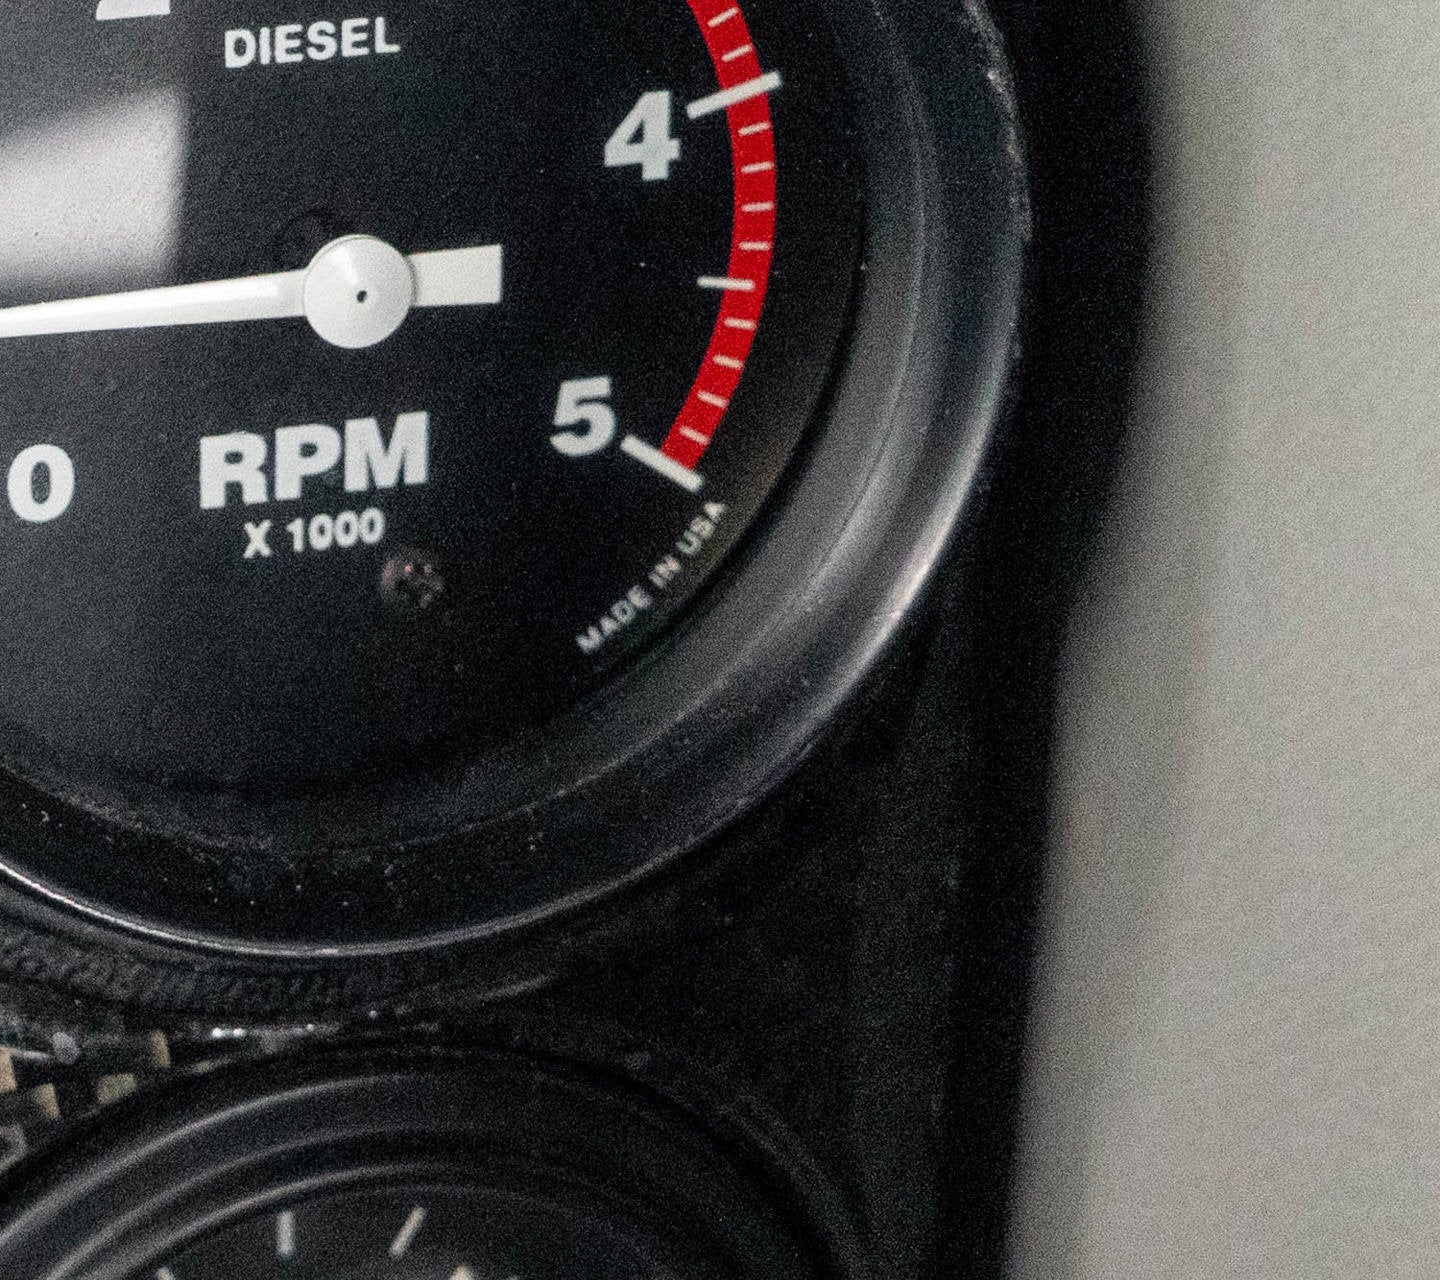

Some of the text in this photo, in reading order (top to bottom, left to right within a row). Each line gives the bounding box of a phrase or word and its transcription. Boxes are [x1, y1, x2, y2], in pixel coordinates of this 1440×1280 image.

[223, 17, 401, 69] DIESEL
[603, 91, 681, 181] 4
[551, 377, 616, 456] 5
[6, 444, 76, 521] 0
[199, 411, 430, 510] RPM
[243, 507, 386, 559] X 1000
[575, 501, 727, 654] MADE IN USA
